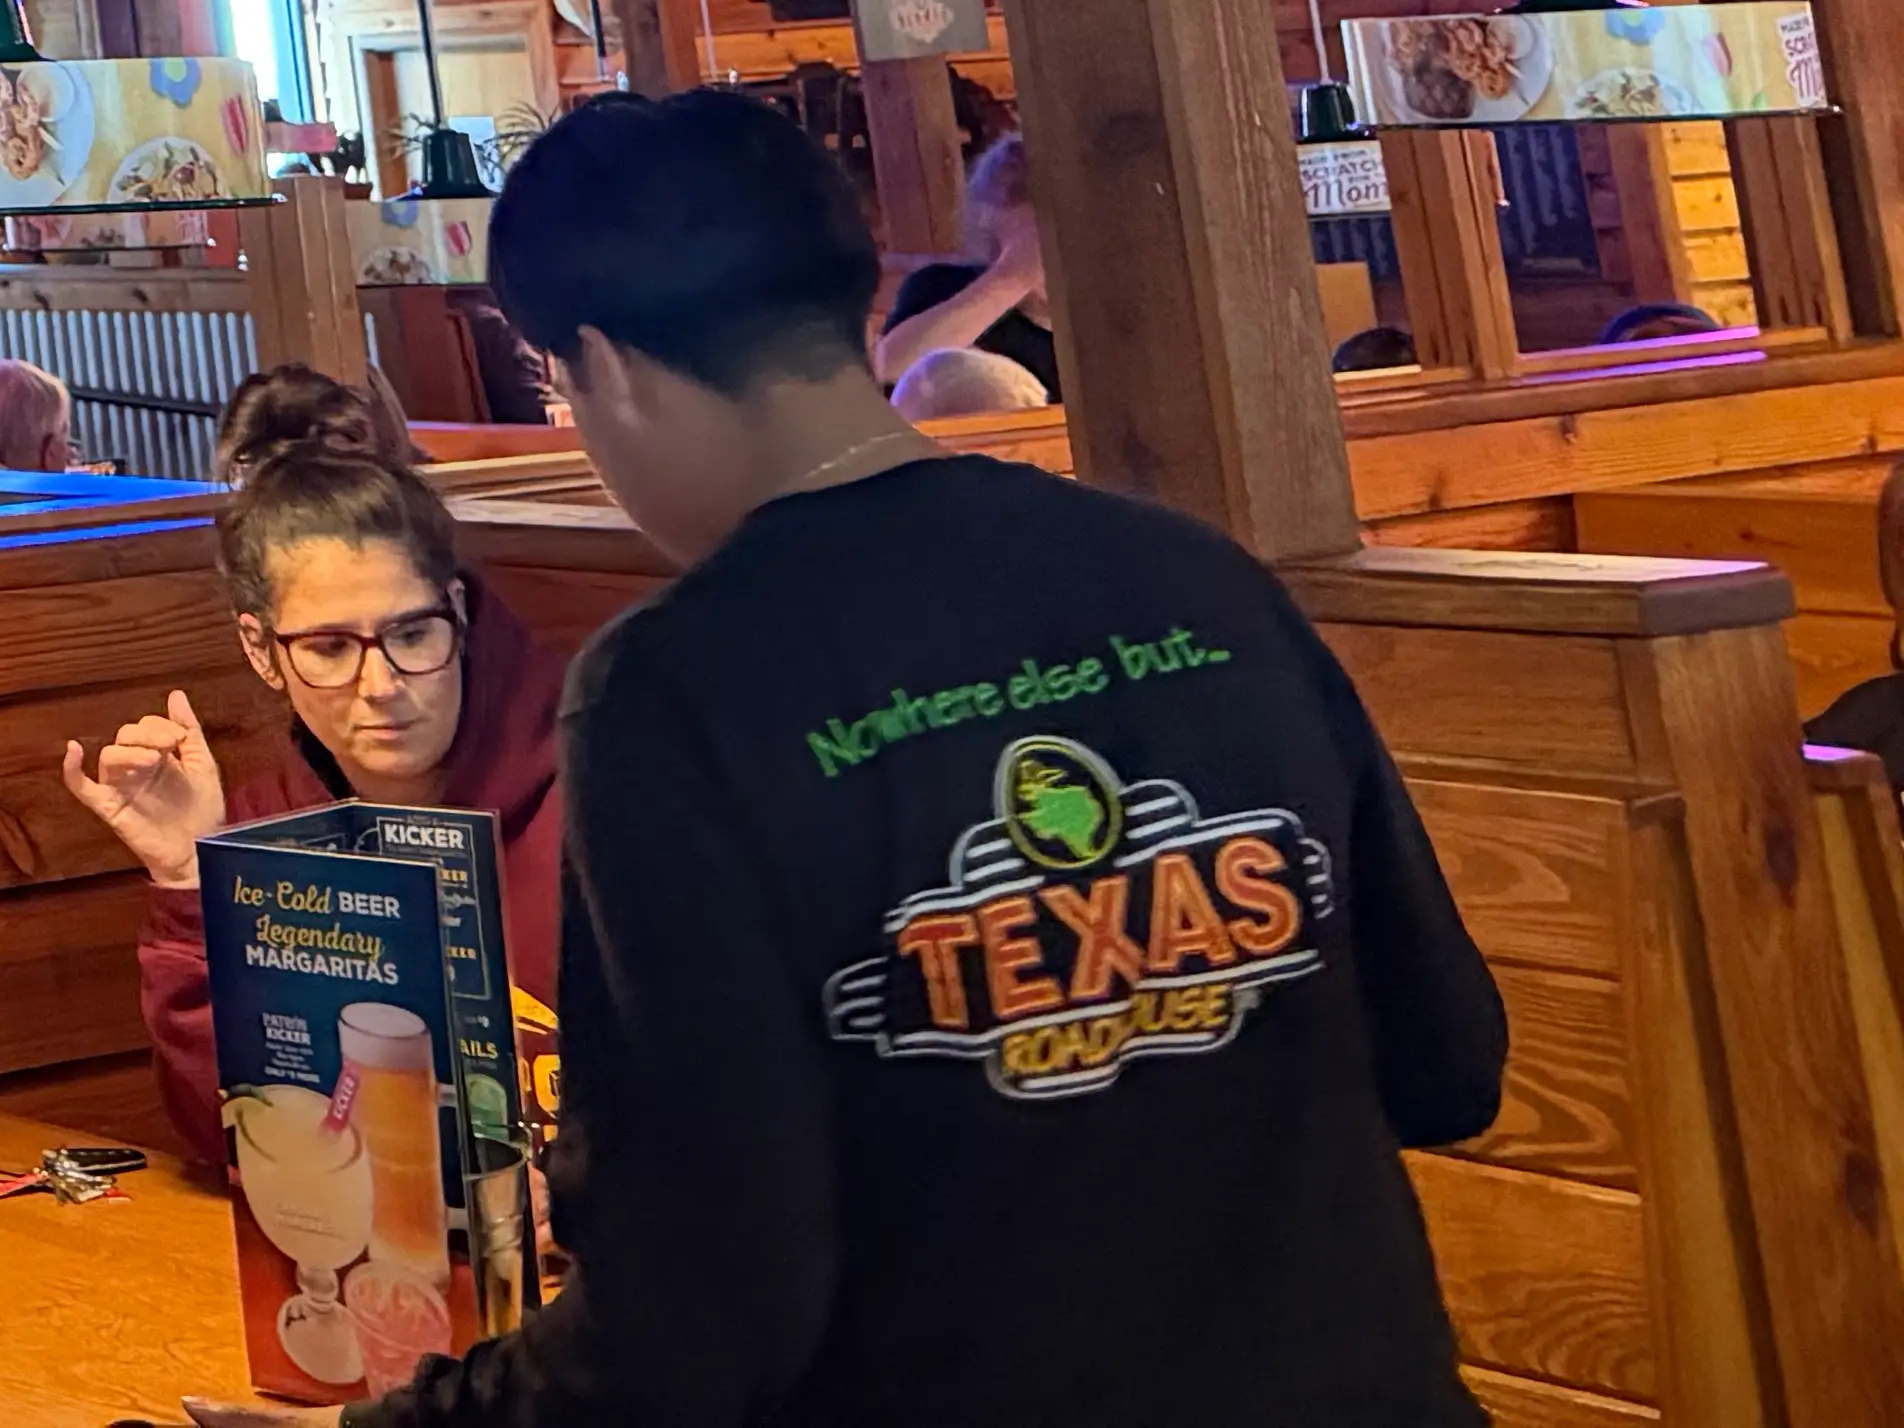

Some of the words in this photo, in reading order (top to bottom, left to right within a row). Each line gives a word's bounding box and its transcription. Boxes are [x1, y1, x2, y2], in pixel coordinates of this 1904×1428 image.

[805, 682, 1005, 777] Nowhere
[1008, 659, 1110, 711] else
[383, 823, 465, 850] KICKER
[232, 875, 333, 914] Ice-Cold
[337, 891, 401, 919] BEER
[255, 913, 386, 963] Legendary
[897, 835, 1302, 1030] TEXAS
[245, 943, 400, 986] MARGARITAS
[1000, 983, 1234, 1075] ROADUSE
